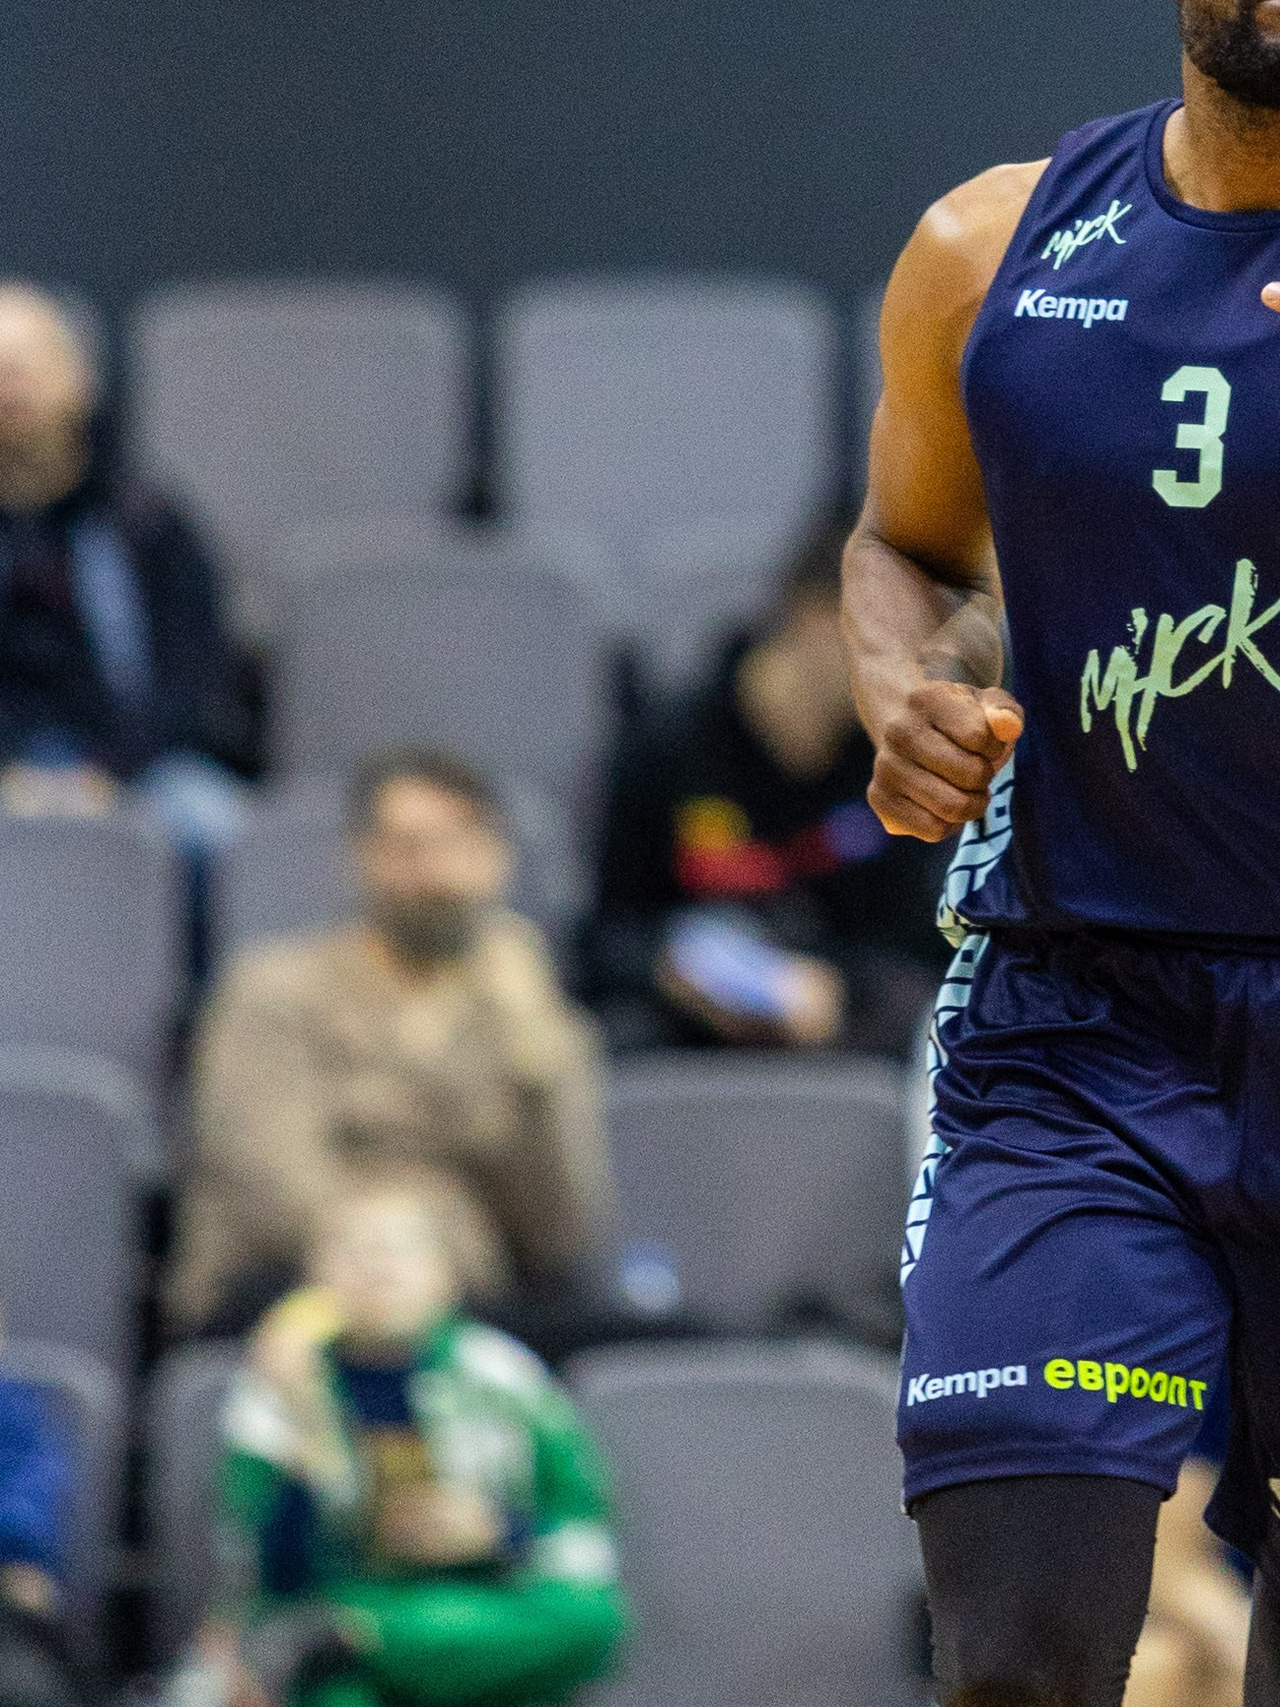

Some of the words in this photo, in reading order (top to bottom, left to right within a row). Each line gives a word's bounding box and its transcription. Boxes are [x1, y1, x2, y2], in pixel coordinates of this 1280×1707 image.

[1014, 289, 1129, 328] Kempa
[1152, 366, 1231, 508] 3
[906, 1365, 1028, 1406] Kempa
[1043, 1358, 1207, 1411] евроопт
